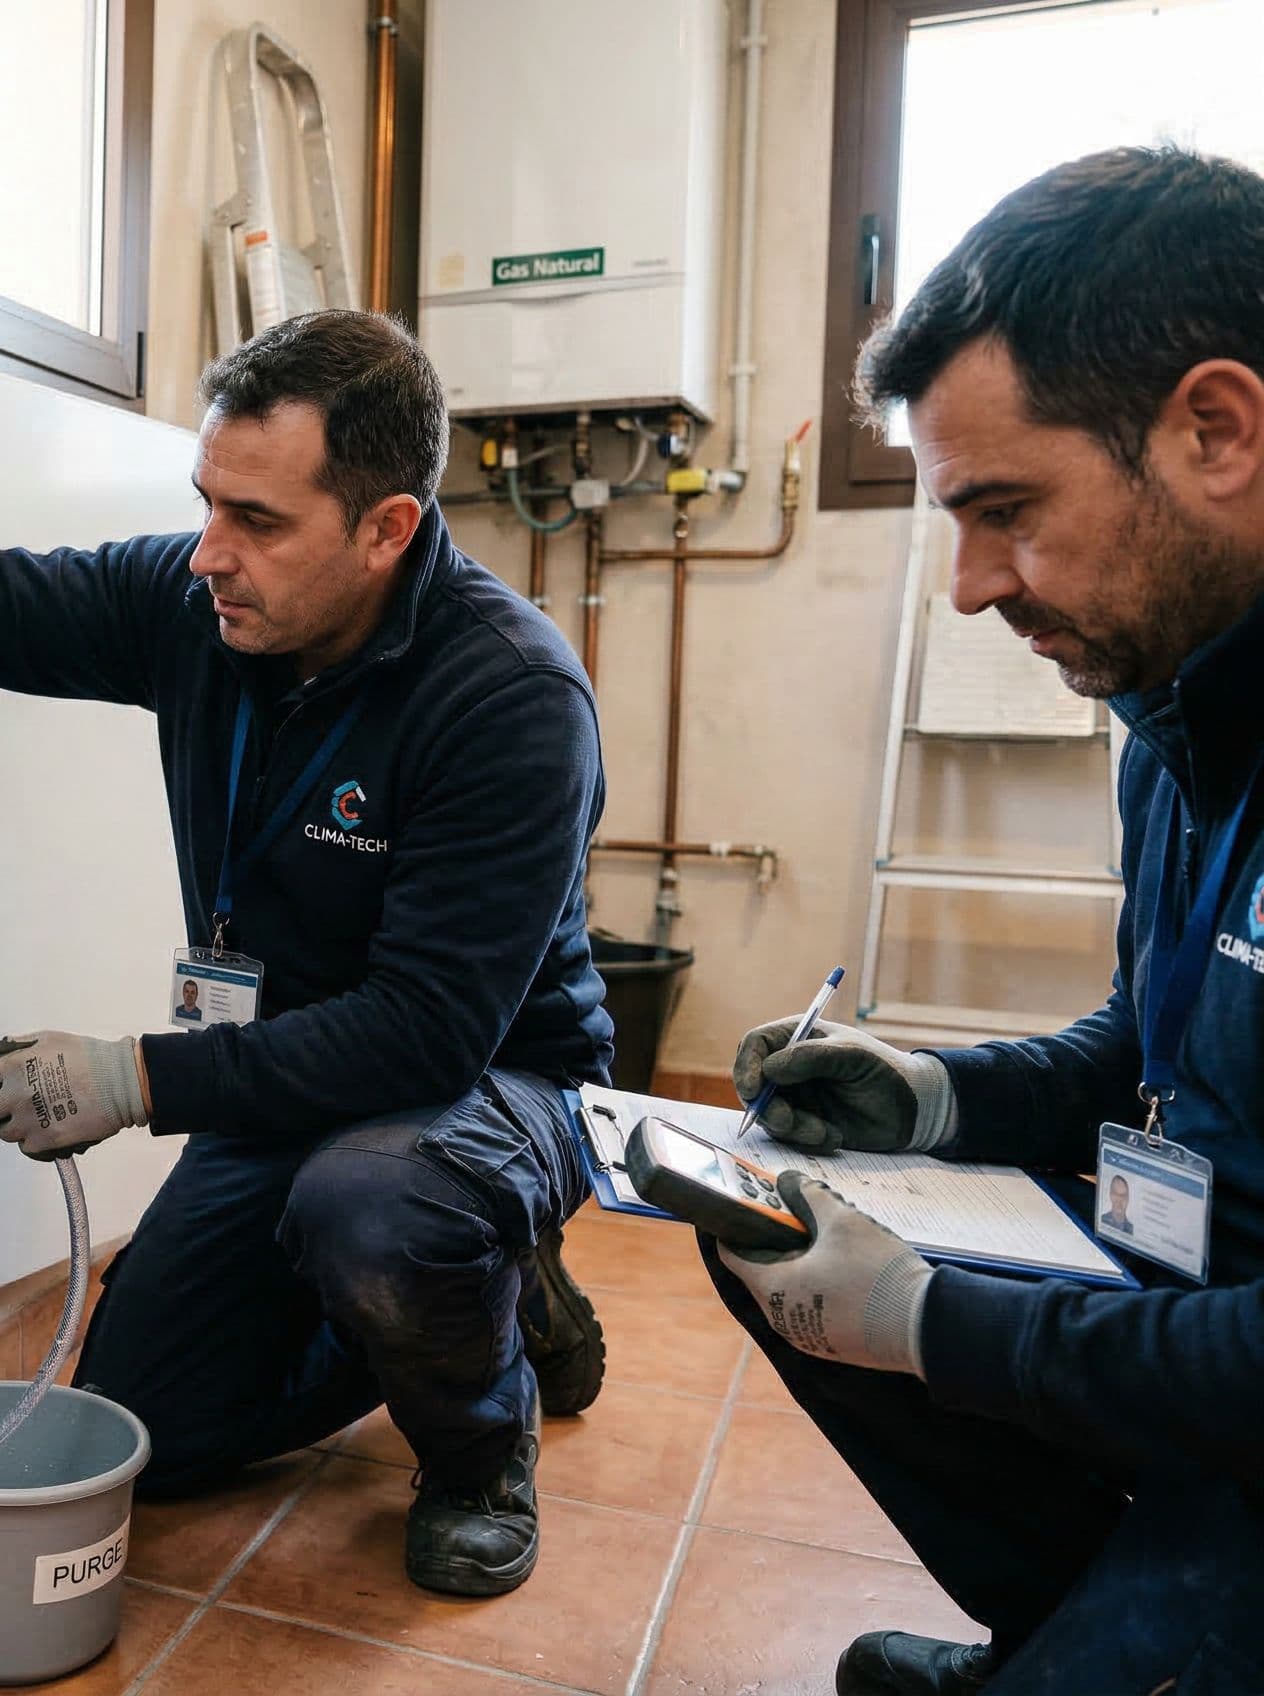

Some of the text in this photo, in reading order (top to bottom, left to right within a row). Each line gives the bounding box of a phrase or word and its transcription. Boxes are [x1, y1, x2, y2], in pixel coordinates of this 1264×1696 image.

[496, 252, 600, 280] Gas Natural
[304, 823, 388, 852] CLIMA-TECH
[53, 1537, 123, 1588] PURGE
